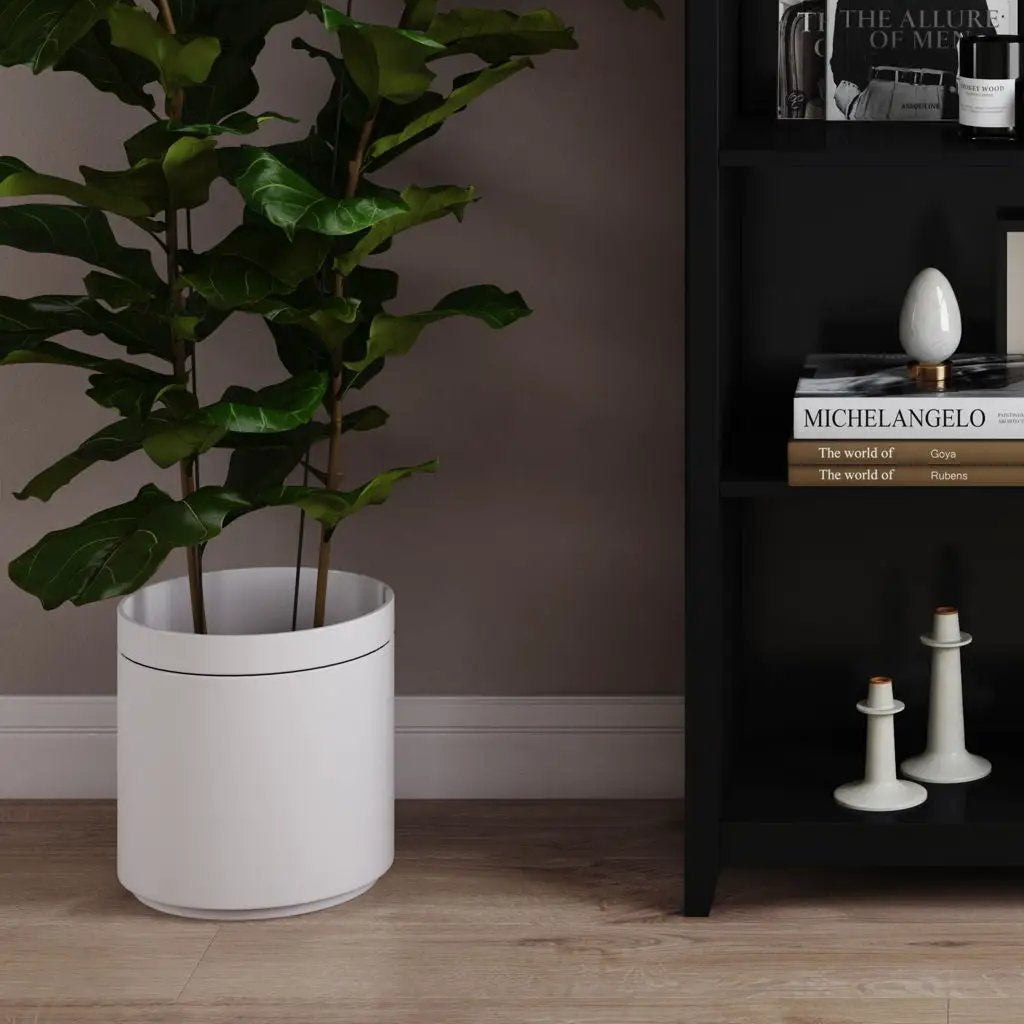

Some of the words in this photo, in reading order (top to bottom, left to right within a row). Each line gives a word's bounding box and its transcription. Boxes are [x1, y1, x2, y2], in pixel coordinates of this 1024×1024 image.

[840, 10, 893, 28] THE
[901, 10, 1000, 28] ALLURE
[869, 30, 904, 49] OF
[804, 408, 986, 428] MICHELANGELO
[819, 447, 841, 459] The
[845, 447, 878, 459] world
[881, 447, 895, 459] of
[930, 449, 957, 460] Goya
[819, 469, 841, 480] The
[845, 469, 878, 480] world
[881, 469, 895, 480] of
[930, 471, 968, 480] Rubens
